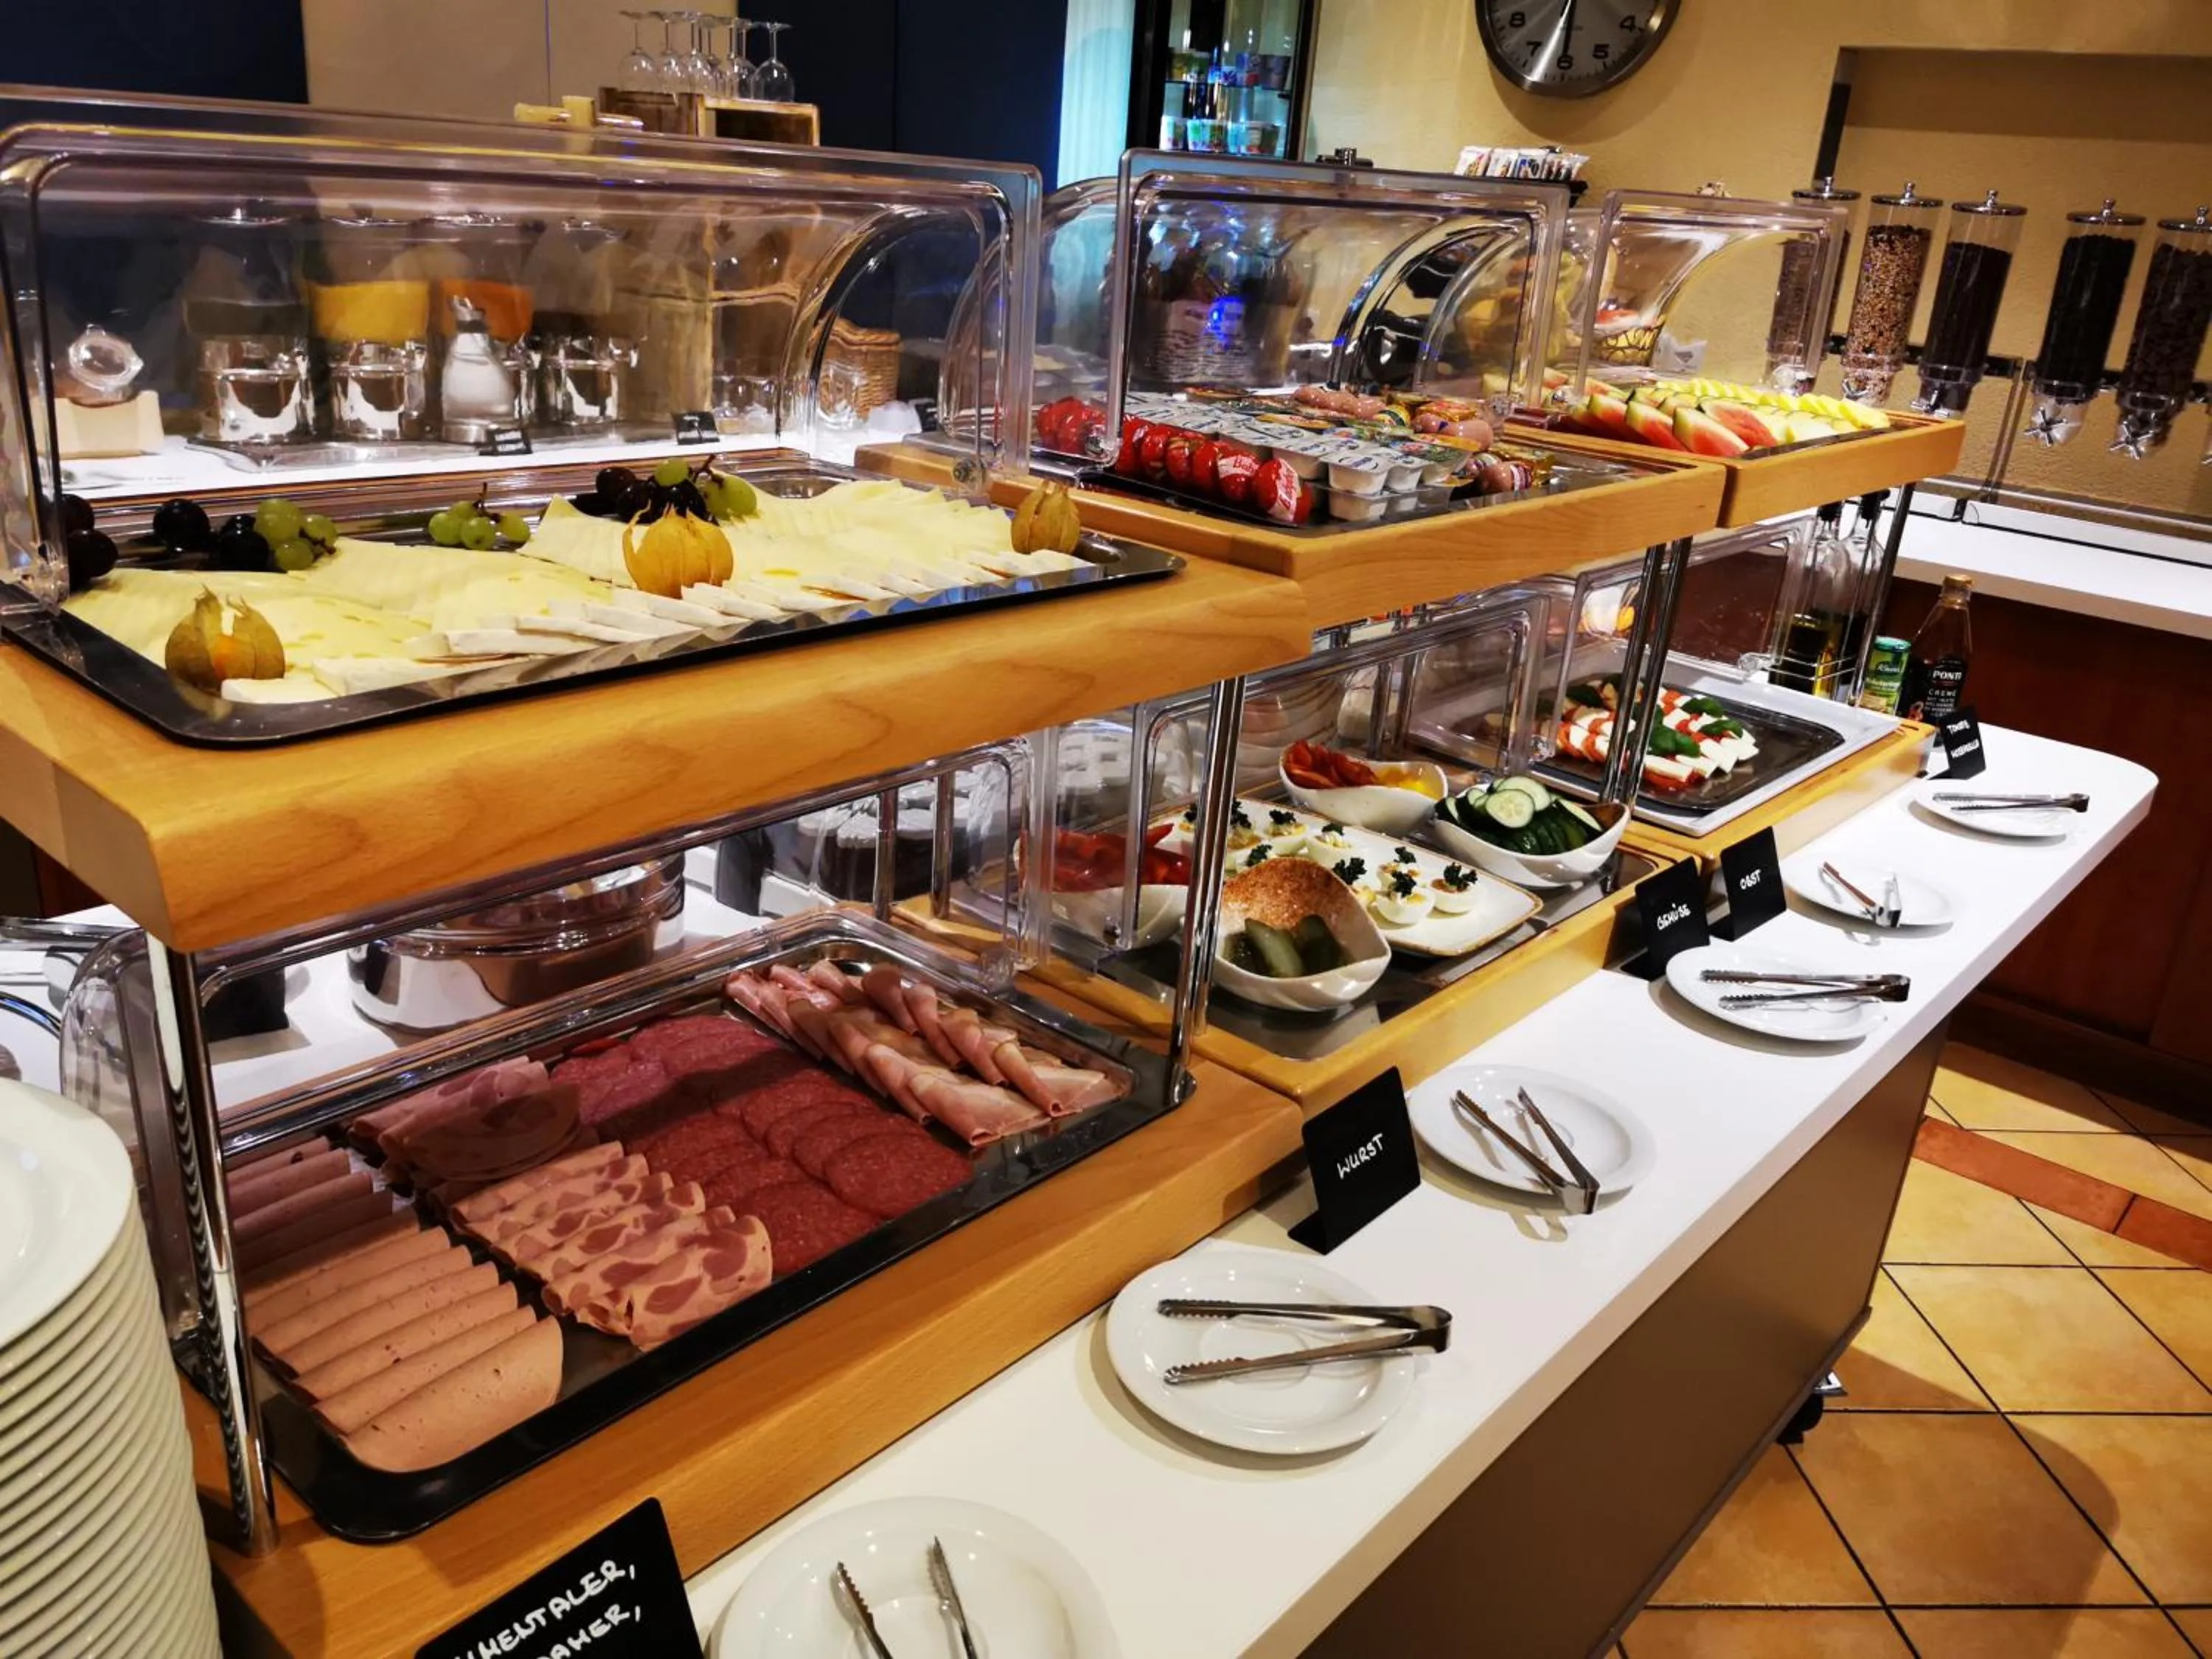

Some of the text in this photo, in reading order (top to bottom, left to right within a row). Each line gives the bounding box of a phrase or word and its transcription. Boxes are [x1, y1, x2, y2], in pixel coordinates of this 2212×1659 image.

[1509, 12, 1526, 27] 8
[1620, 15, 1636, 32] 4
[1526, 41, 1543, 57] 7
[1593, 44, 1610, 59] 5
[1557, 55, 1573, 70] 6
[1932, 669, 1963, 681] PONTI
[1739, 869, 1761, 890] OBST
[1337, 1133, 1383, 1180] WURST
